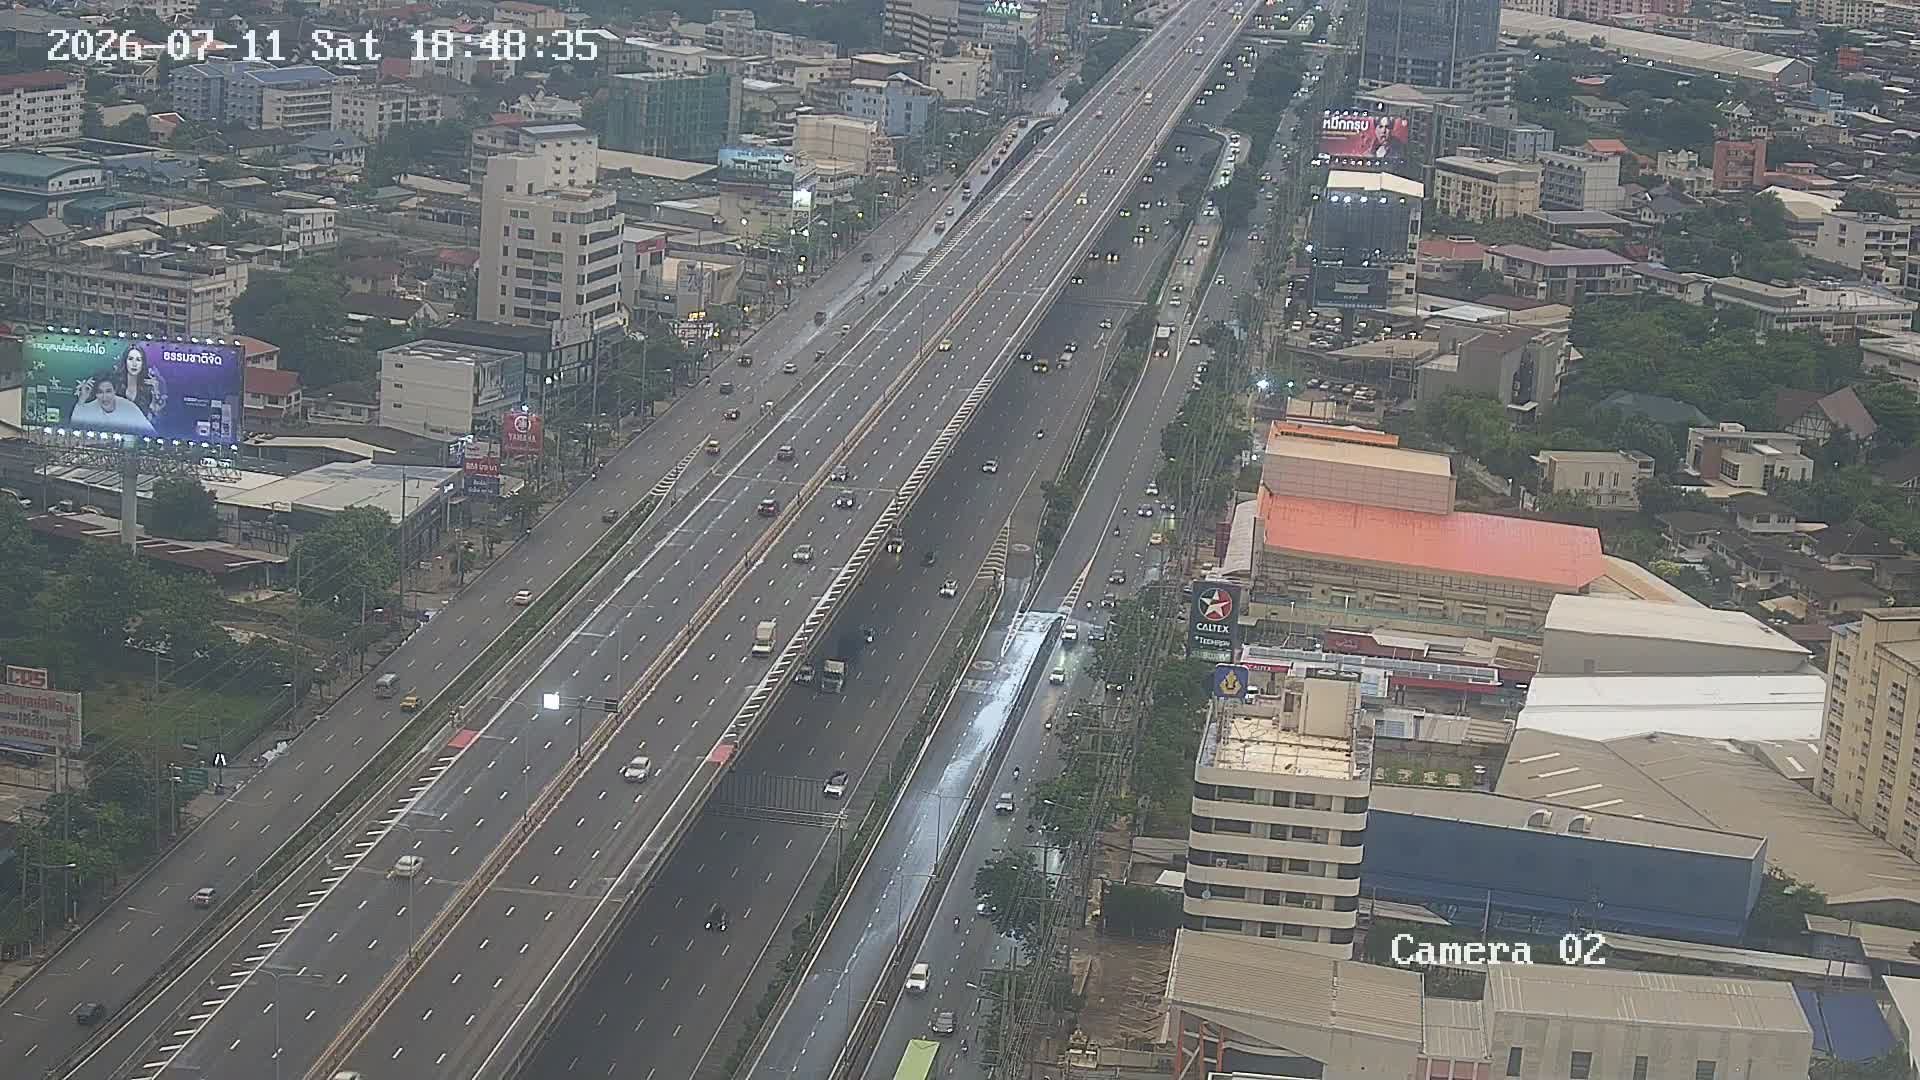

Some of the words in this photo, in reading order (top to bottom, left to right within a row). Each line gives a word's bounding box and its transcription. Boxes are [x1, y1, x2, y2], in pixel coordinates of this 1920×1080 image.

[986, 6, 1018, 16] AVANA
[508, 432, 537, 443] YAMAHA
[1196, 623, 1230, 634] CALTEX
